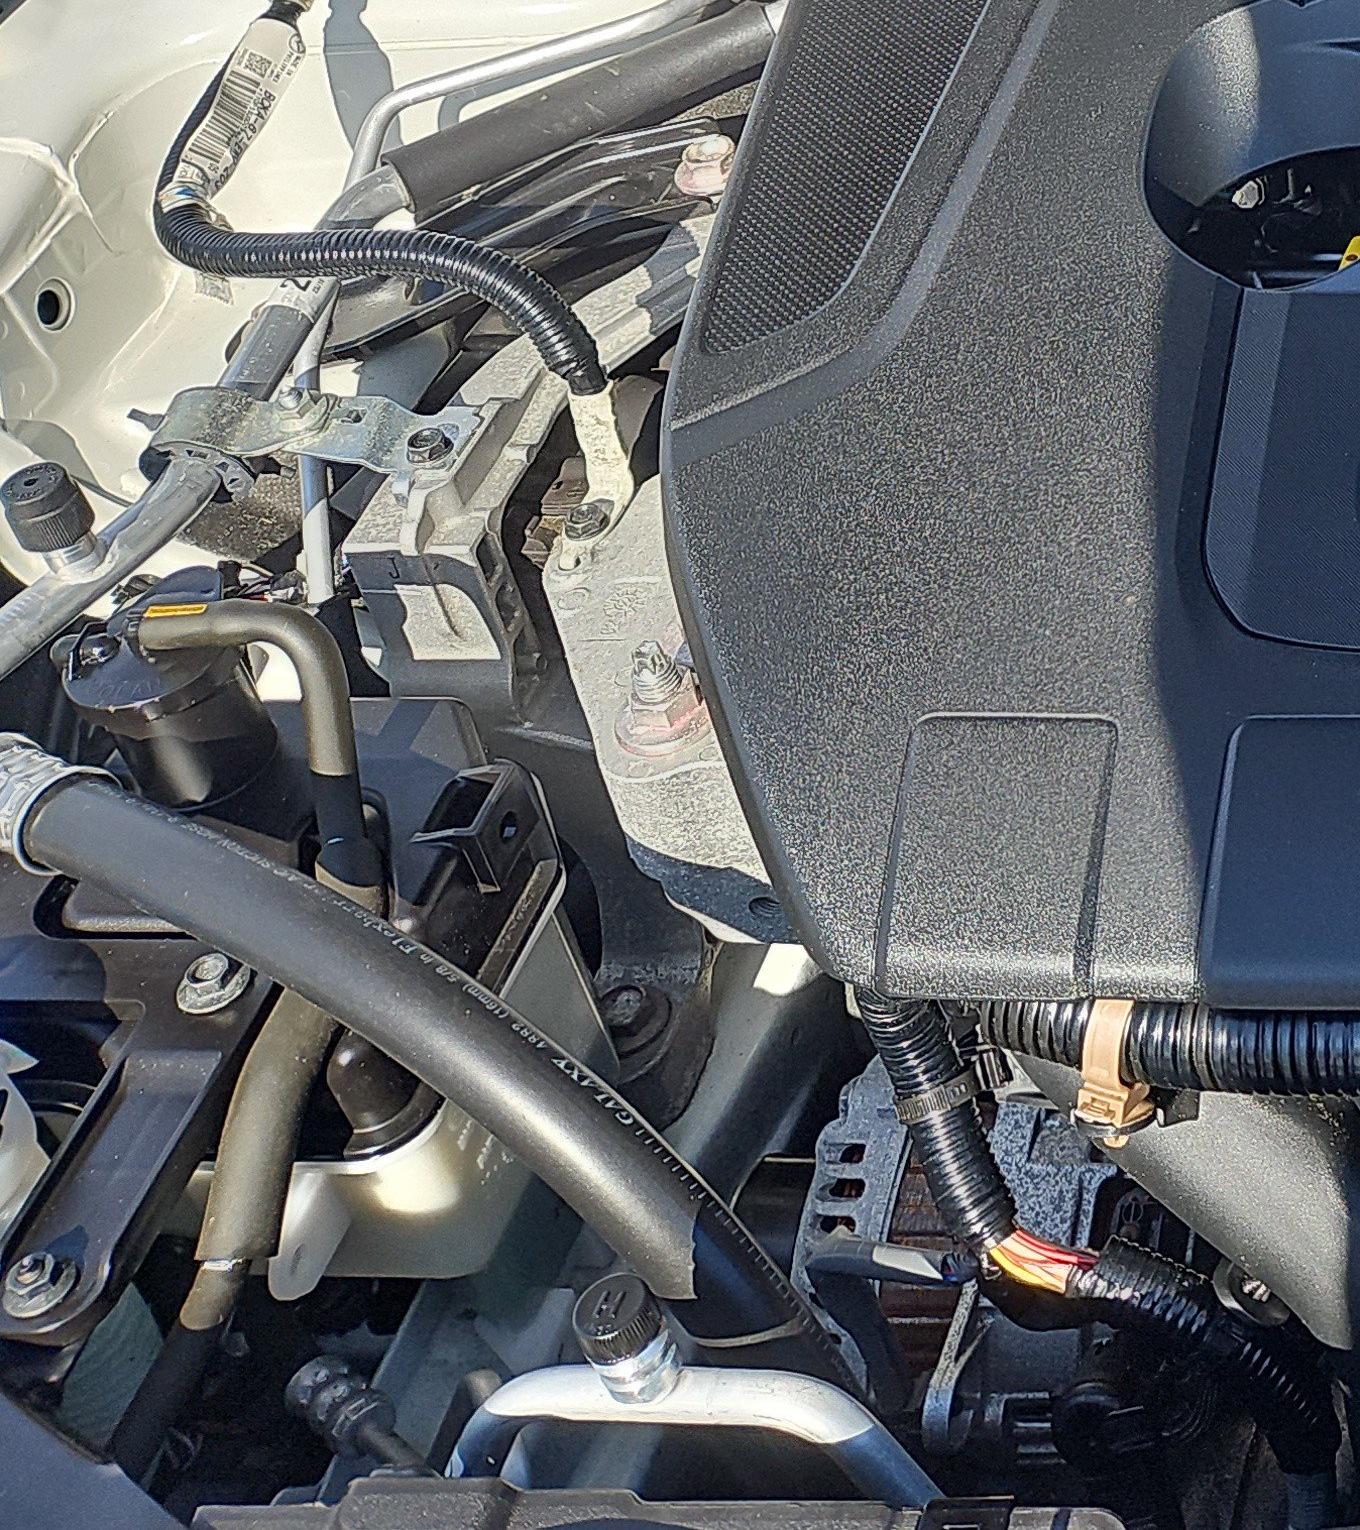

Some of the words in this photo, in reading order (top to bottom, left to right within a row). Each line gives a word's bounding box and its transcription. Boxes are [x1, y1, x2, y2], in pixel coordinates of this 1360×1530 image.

[436, 965, 459, 983] 5/8
[462, 983, 510, 1019] (16mm)
[510, 1022, 548, 1050] 4882
[551, 1057, 634, 1125] GALAXY
[593, 1291, 627, 1319] H
